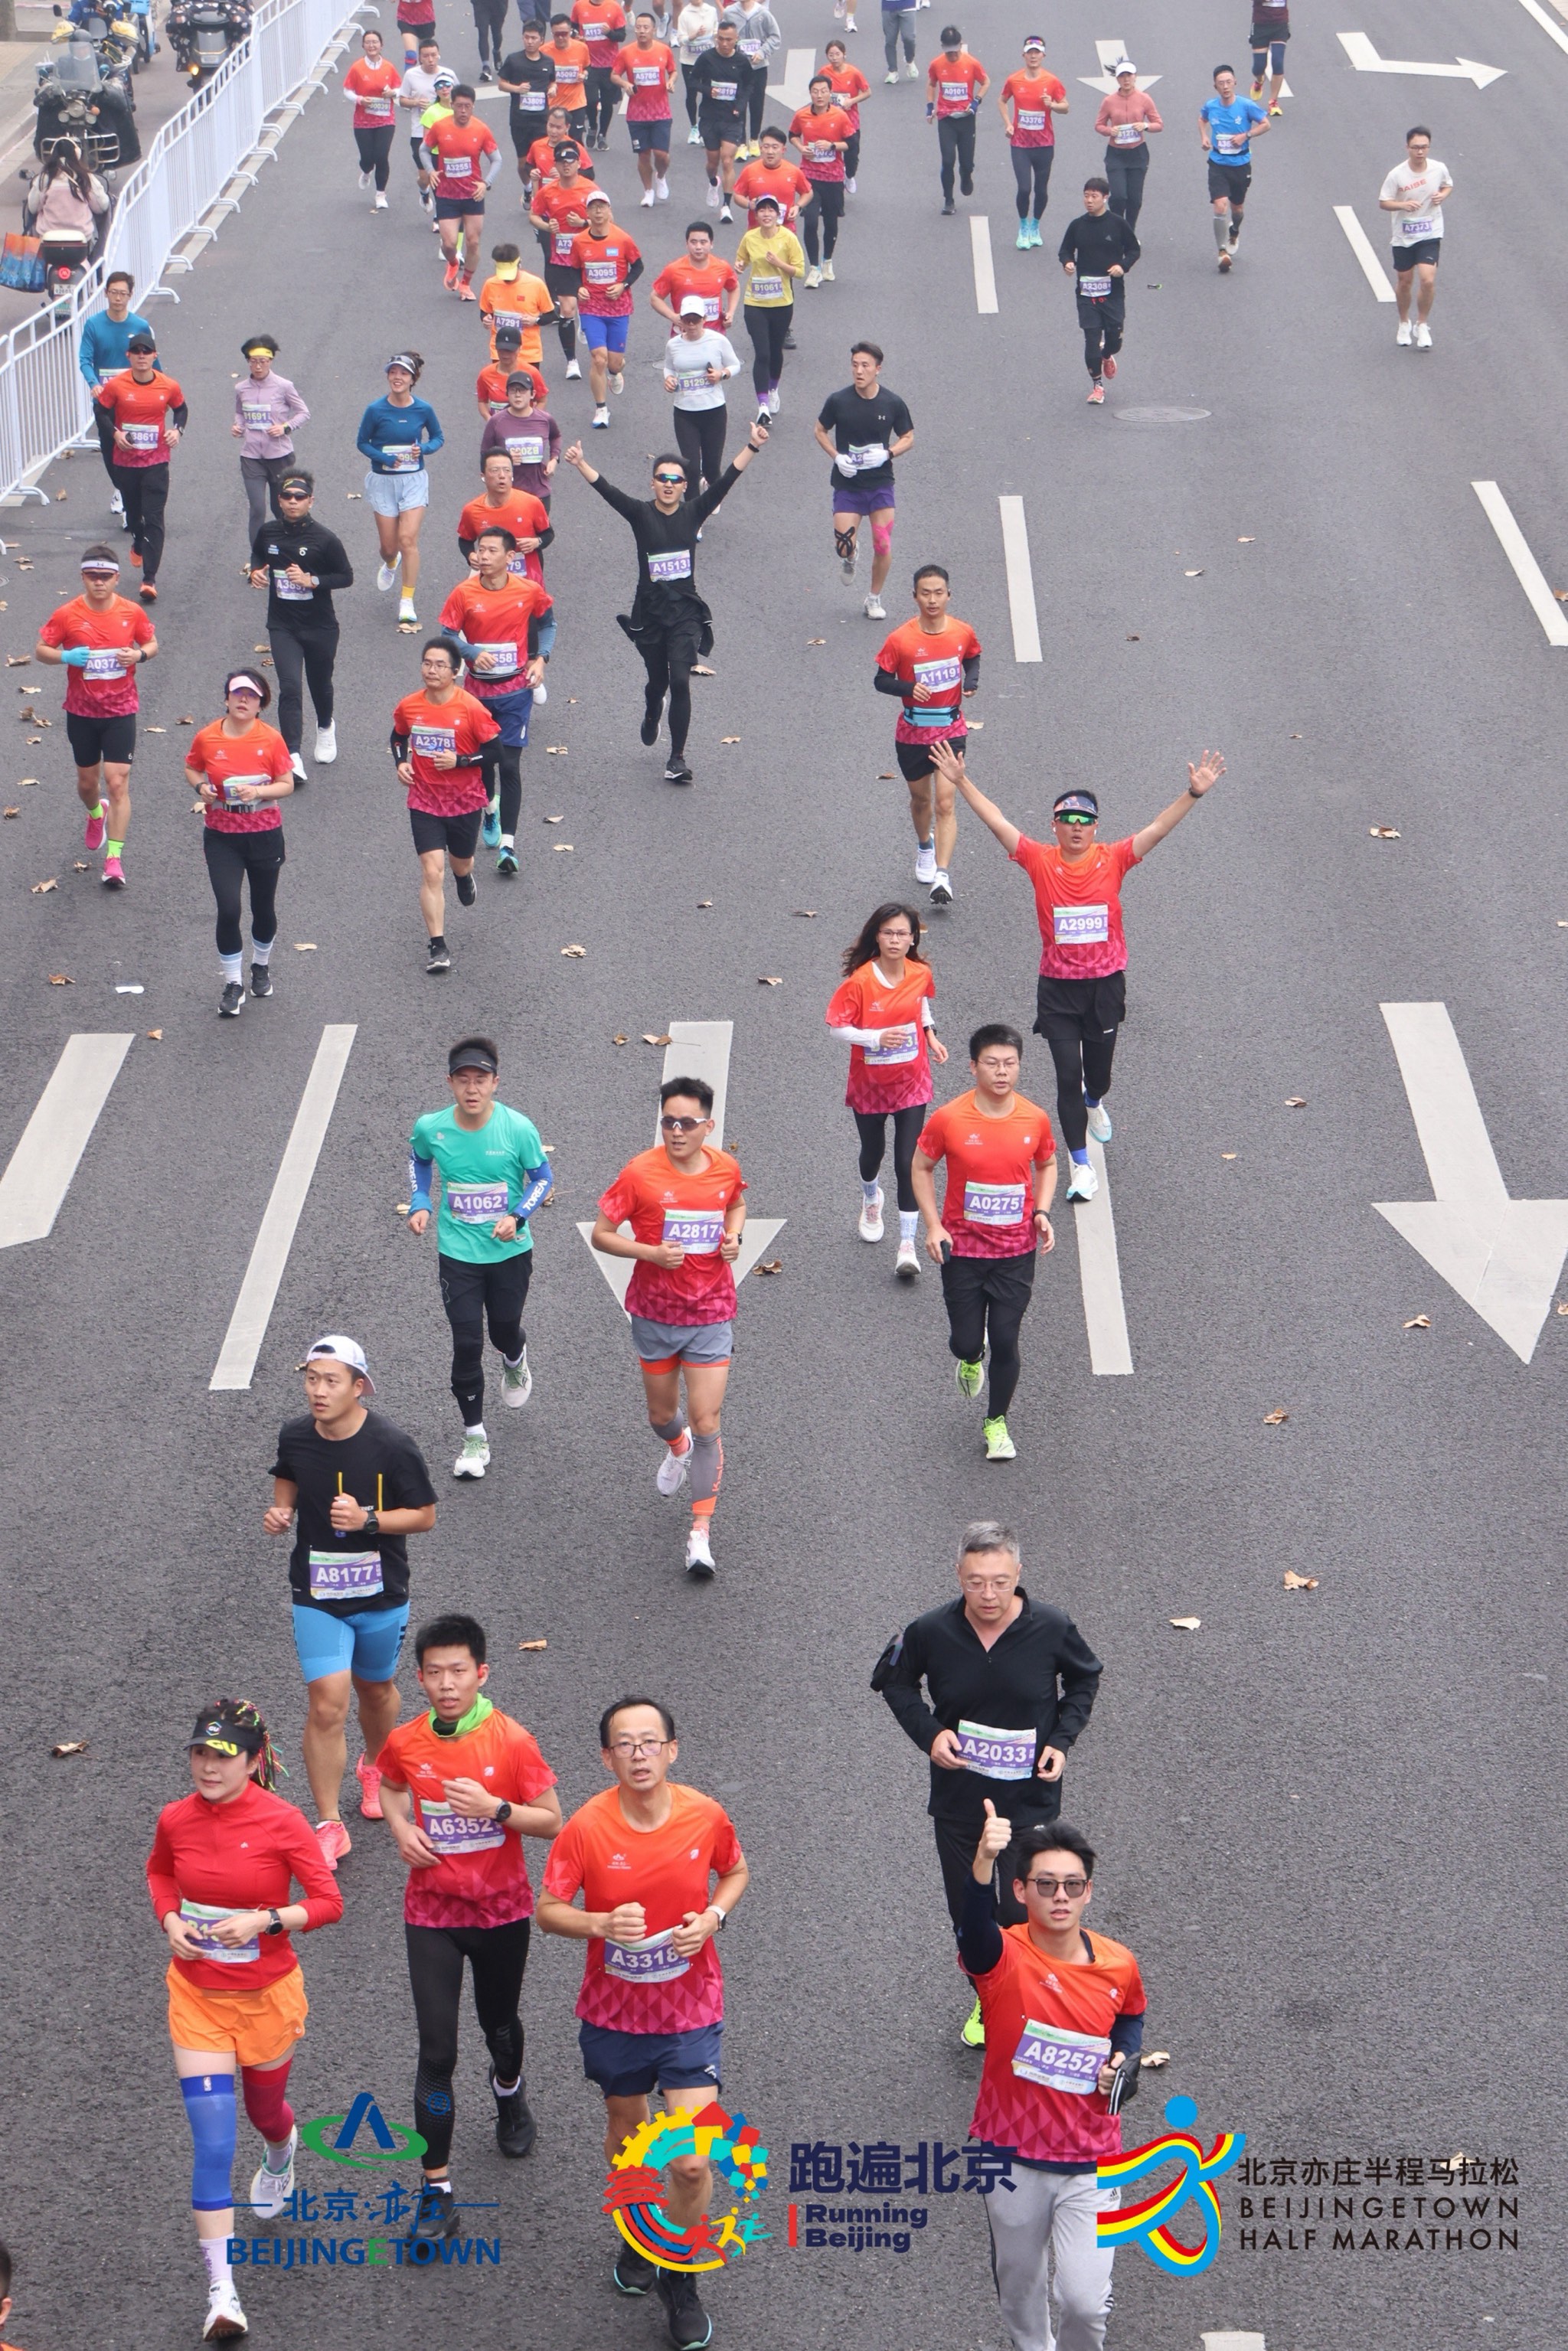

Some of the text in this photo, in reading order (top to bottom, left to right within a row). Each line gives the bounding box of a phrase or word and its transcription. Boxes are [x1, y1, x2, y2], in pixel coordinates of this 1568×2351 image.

[1405, 222, 1429, 231] A7373
[496, 318, 521, 327] A7291
[653, 560, 687, 573] A1513
[920, 668, 956, 683] A1119
[416, 735, 451, 747] A2378
[1059, 917, 1102, 932] A2999
[453, 1195, 502, 1210] A1062
[969, 1195, 1019, 1210] A0275
[668, 1223, 720, 1238] A2817
[316, 1564, 373, 1584] A8177
[963, 1739, 1026, 1762] A2033
[430, 1816, 493, 1836] A6352
[611, 1947, 679, 1967] A3318
[1024, 2040, 1096, 2075] A8252
